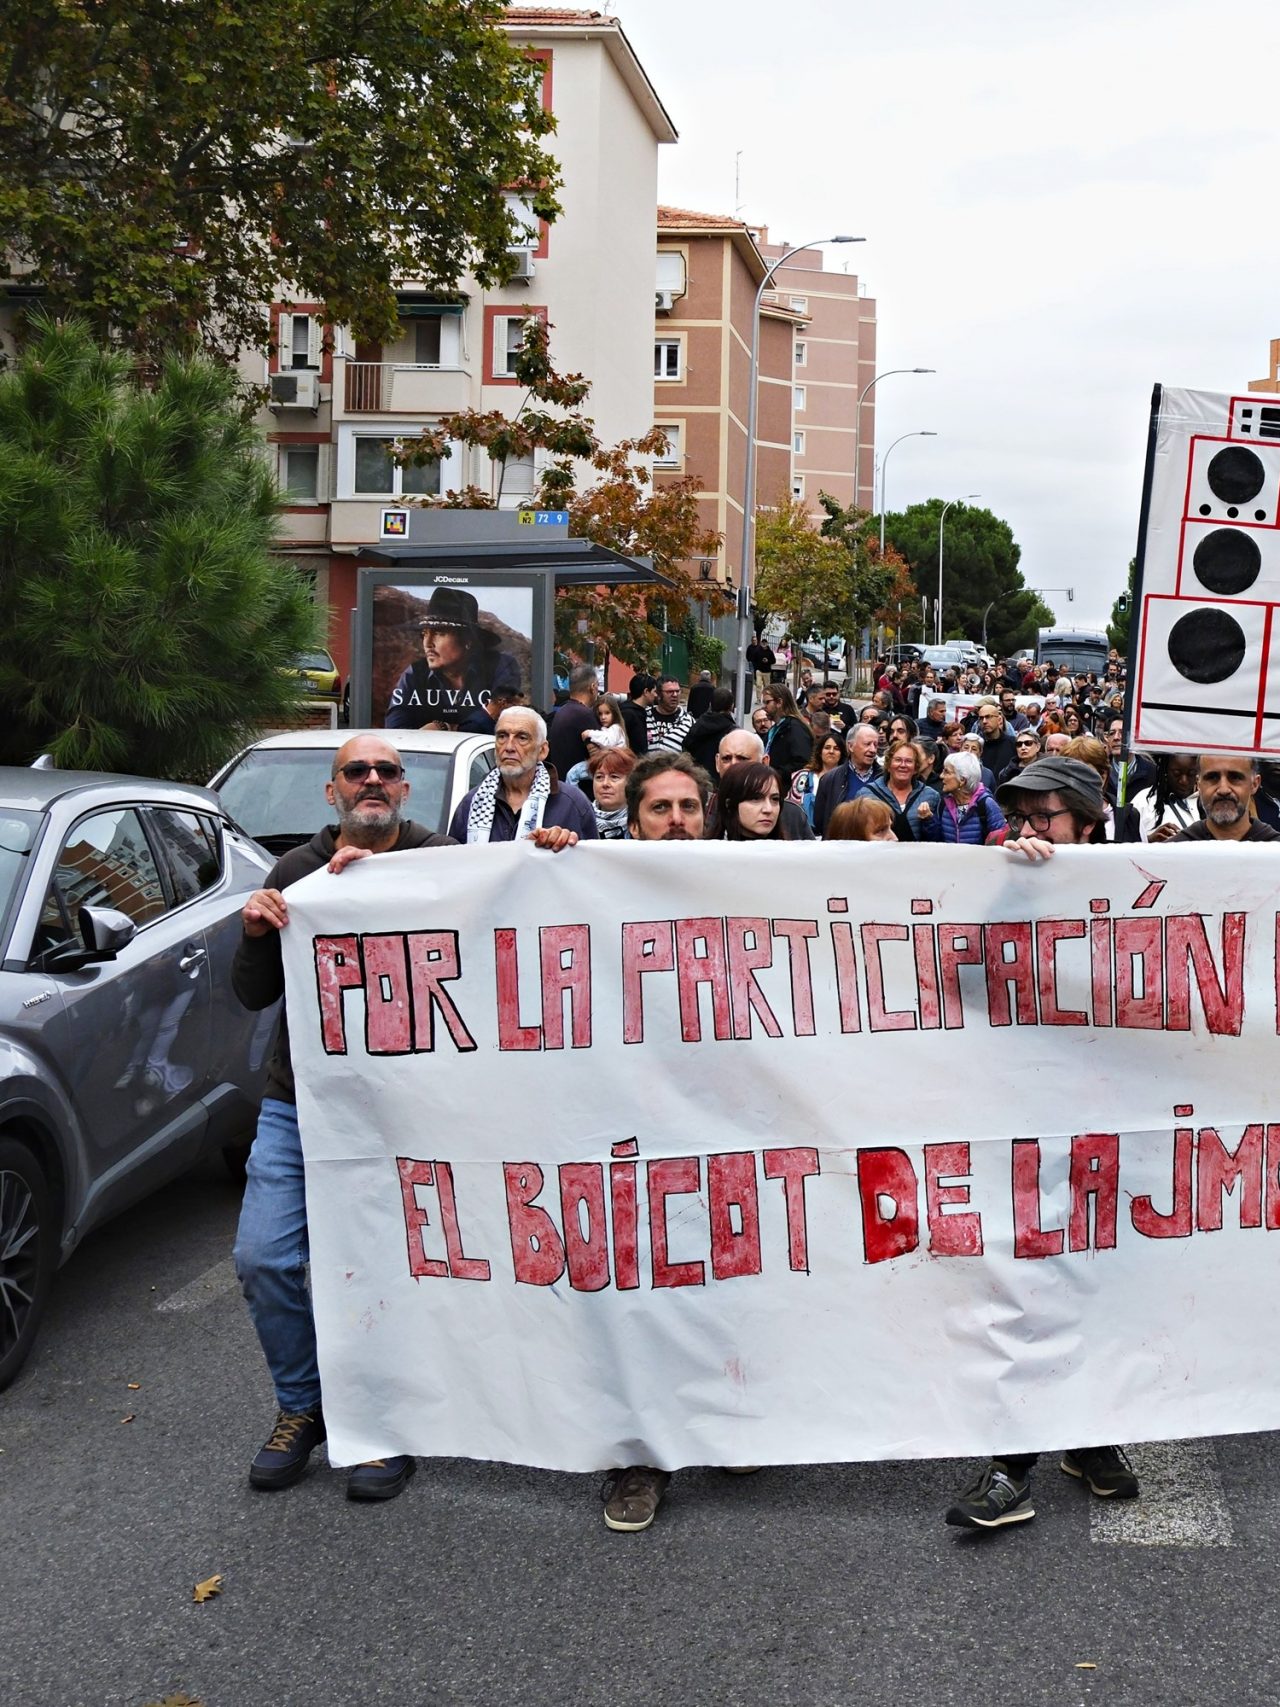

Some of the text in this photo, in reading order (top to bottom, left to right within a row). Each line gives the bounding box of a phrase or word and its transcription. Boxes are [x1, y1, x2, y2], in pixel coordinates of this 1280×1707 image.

[522, 513, 563, 524] N2 72 9
[433, 575, 469, 583] JCDecaux
[392, 688, 492, 706] SAUVAG
[313, 929, 477, 1056] POR
[494, 924, 592, 1051] LA
[396, 1156, 491, 1281] EL
[856, 1141, 984, 1264] DE
[1012, 1132, 1120, 1259] LA
